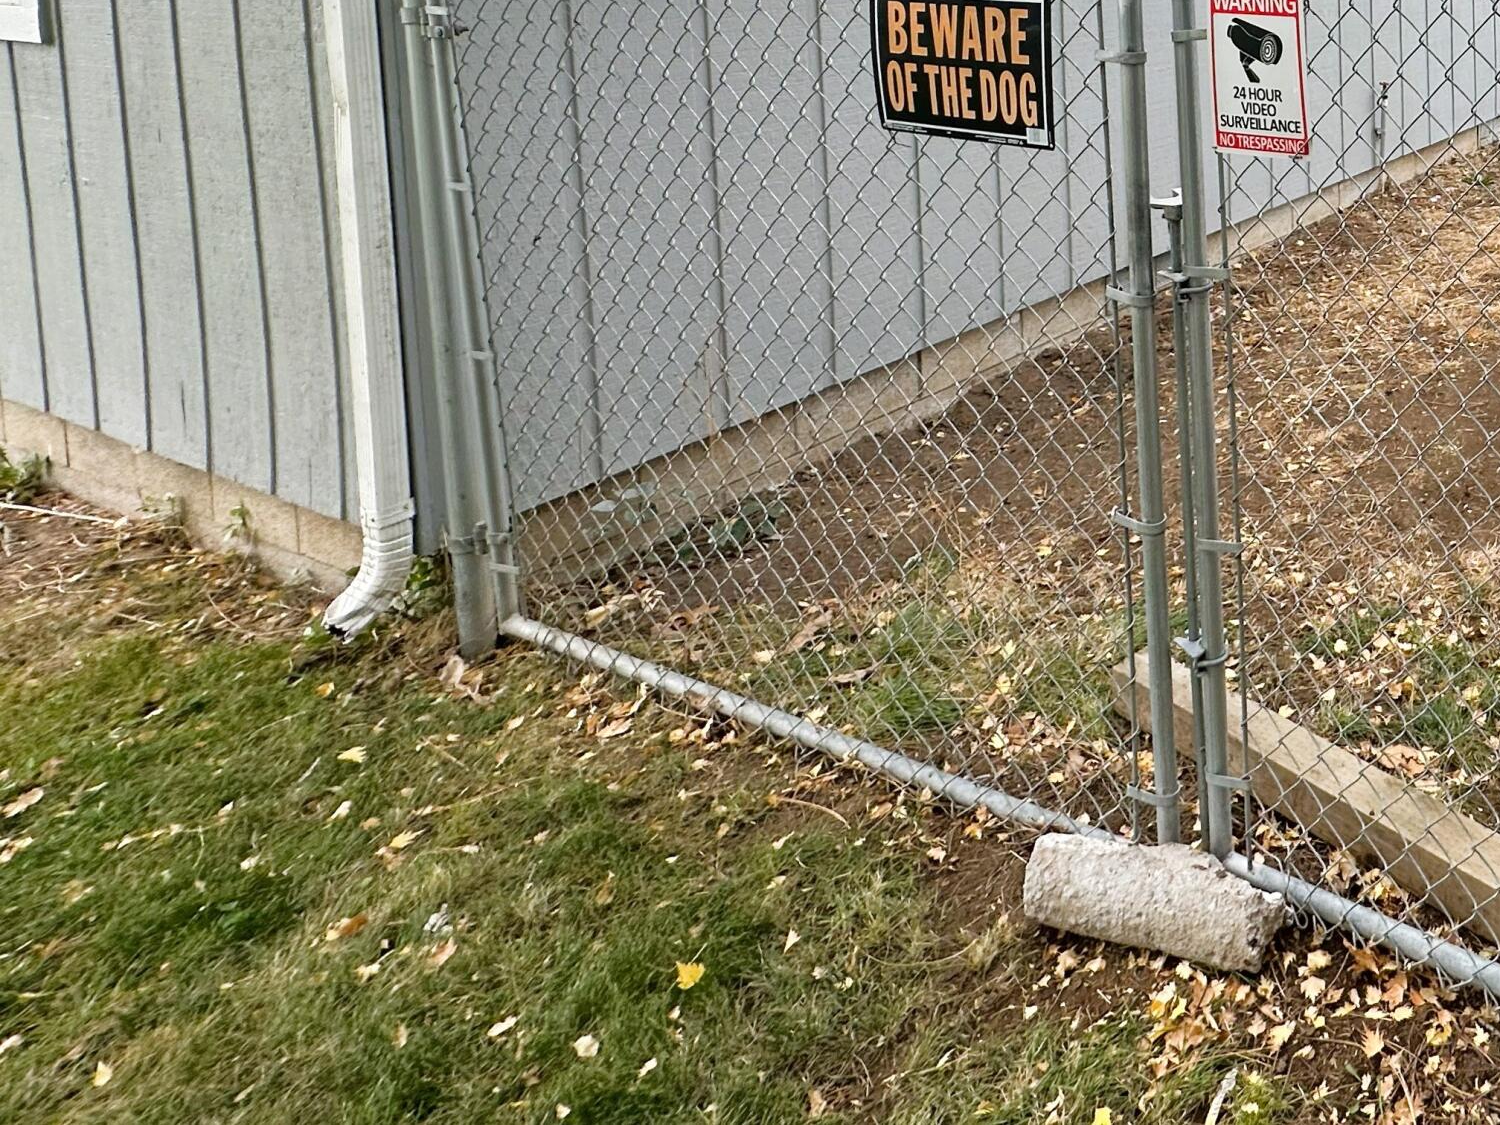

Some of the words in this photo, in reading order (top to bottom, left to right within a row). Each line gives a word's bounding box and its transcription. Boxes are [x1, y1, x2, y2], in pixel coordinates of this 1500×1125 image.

[887, 0, 1030, 65] BEWARE
[887, 60, 918, 113] OF
[924, 64, 977, 120] THE
[980, 69, 1038, 127] DOG
[1233, 86, 1247, 100] 24
[1248, 87, 1283, 103] HOUR
[1240, 101, 1277, 117] VIDEO
[1220, 114, 1302, 134] SURVEILLANCE
[1219, 133, 1235, 146] NO
[1236, 134, 1306, 154] TRESPASSING
